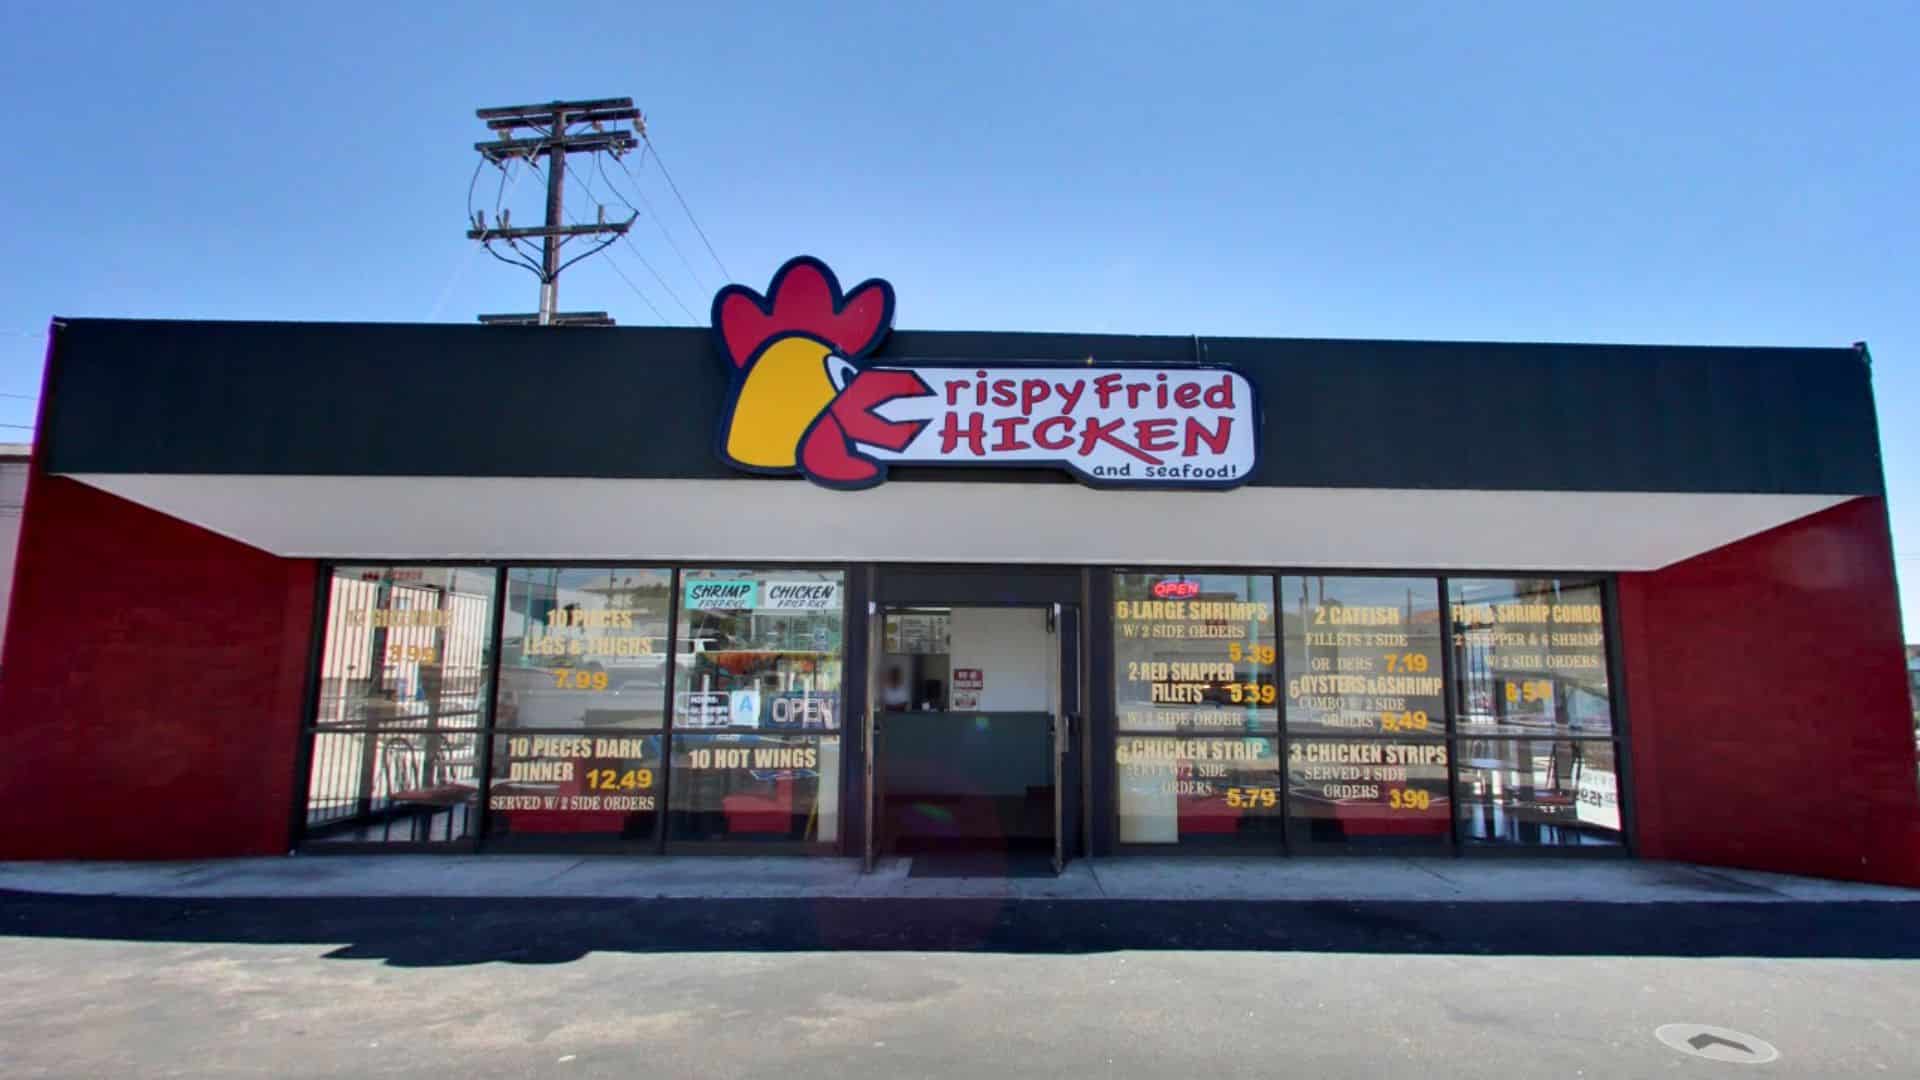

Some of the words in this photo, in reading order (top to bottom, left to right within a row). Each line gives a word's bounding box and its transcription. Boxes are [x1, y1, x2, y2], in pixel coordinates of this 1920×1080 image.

[1093, 372, 1236, 411] Fried
[1094, 463, 1131, 477] and
[1145, 462, 1238, 478] seafood!
[690, 584, 751, 600] SHRIMP
[769, 585, 835, 600] CHICKEN
[1154, 583, 1199, 597] OPEN
[547, 608, 567, 628] 10
[1189, 601, 1267, 621] SHRIMPS
[1314, 606, 1327, 625] 2
[1330, 606, 1400, 626] CATFISH
[1152, 624, 1186, 639] SIDE
[1189, 624, 1245, 639] ORDERS
[1305, 632, 1361, 647] FILLETS
[1376, 633, 1409, 647] SIDE
[1171, 662, 1235, 681] SNAPPER
[1384, 652, 1429, 673] 7.19
[1546, 655, 1600, 669] ORDERS
[553, 667, 609, 692] 7.99
[1152, 682, 1204, 703] FILLETS
[739, 694, 753, 713] A
[772, 697, 834, 724] OPEN
[1376, 698, 1407, 711] SIDE
[1193, 711, 1243, 727] ORDER
[509, 738, 530, 757] 10
[533, 738, 592, 759] PIECES
[595, 738, 643, 760] DARK
[688, 749, 711, 769] 10
[714, 749, 748, 769] HOT
[753, 748, 817, 769] WINGS
[1211, 740, 1264, 761] STRIP
[1386, 745, 1448, 765] STRIPS
[510, 762, 574, 782] DINNER
[586, 768, 653, 791] 12.49
[1200, 764, 1228, 777] SIDE
[1375, 767, 1408, 782] SIDE
[1226, 787, 1277, 808] 5.79
[1323, 783, 1380, 799] ORDERS
[490, 796, 541, 811] SERVED
[570, 796, 601, 811] SIDE
[604, 796, 655, 811] ORDERS
